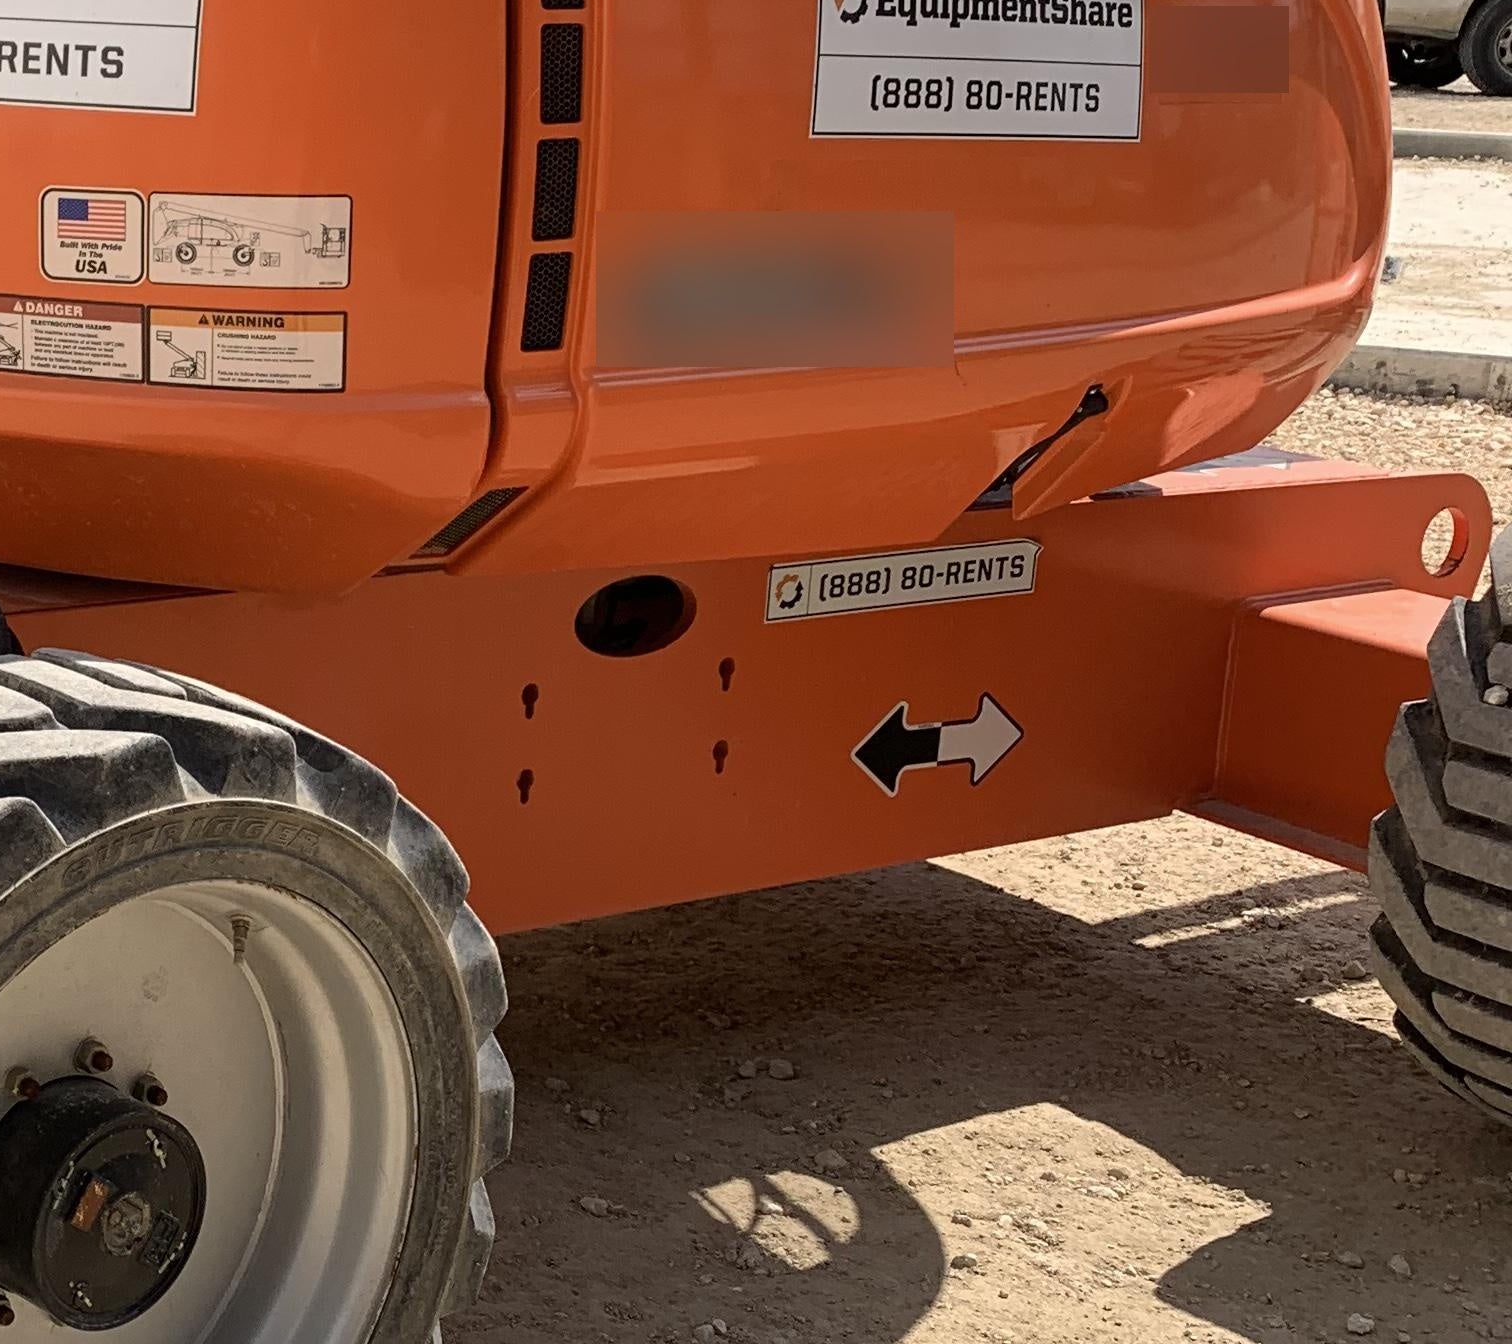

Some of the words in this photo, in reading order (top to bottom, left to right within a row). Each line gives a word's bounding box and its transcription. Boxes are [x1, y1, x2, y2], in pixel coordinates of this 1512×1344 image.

[870, 74, 953, 112] (888)
[966, 80, 1100, 113] 80-RENTS
[81, 242, 99, 250] With
[75, 259, 108, 274] USA
[25, 301, 84, 318] DANGER
[212, 314, 285, 329] WARNING
[819, 567, 890, 602] (888)
[901, 554, 1026, 590] 80-RENTS
